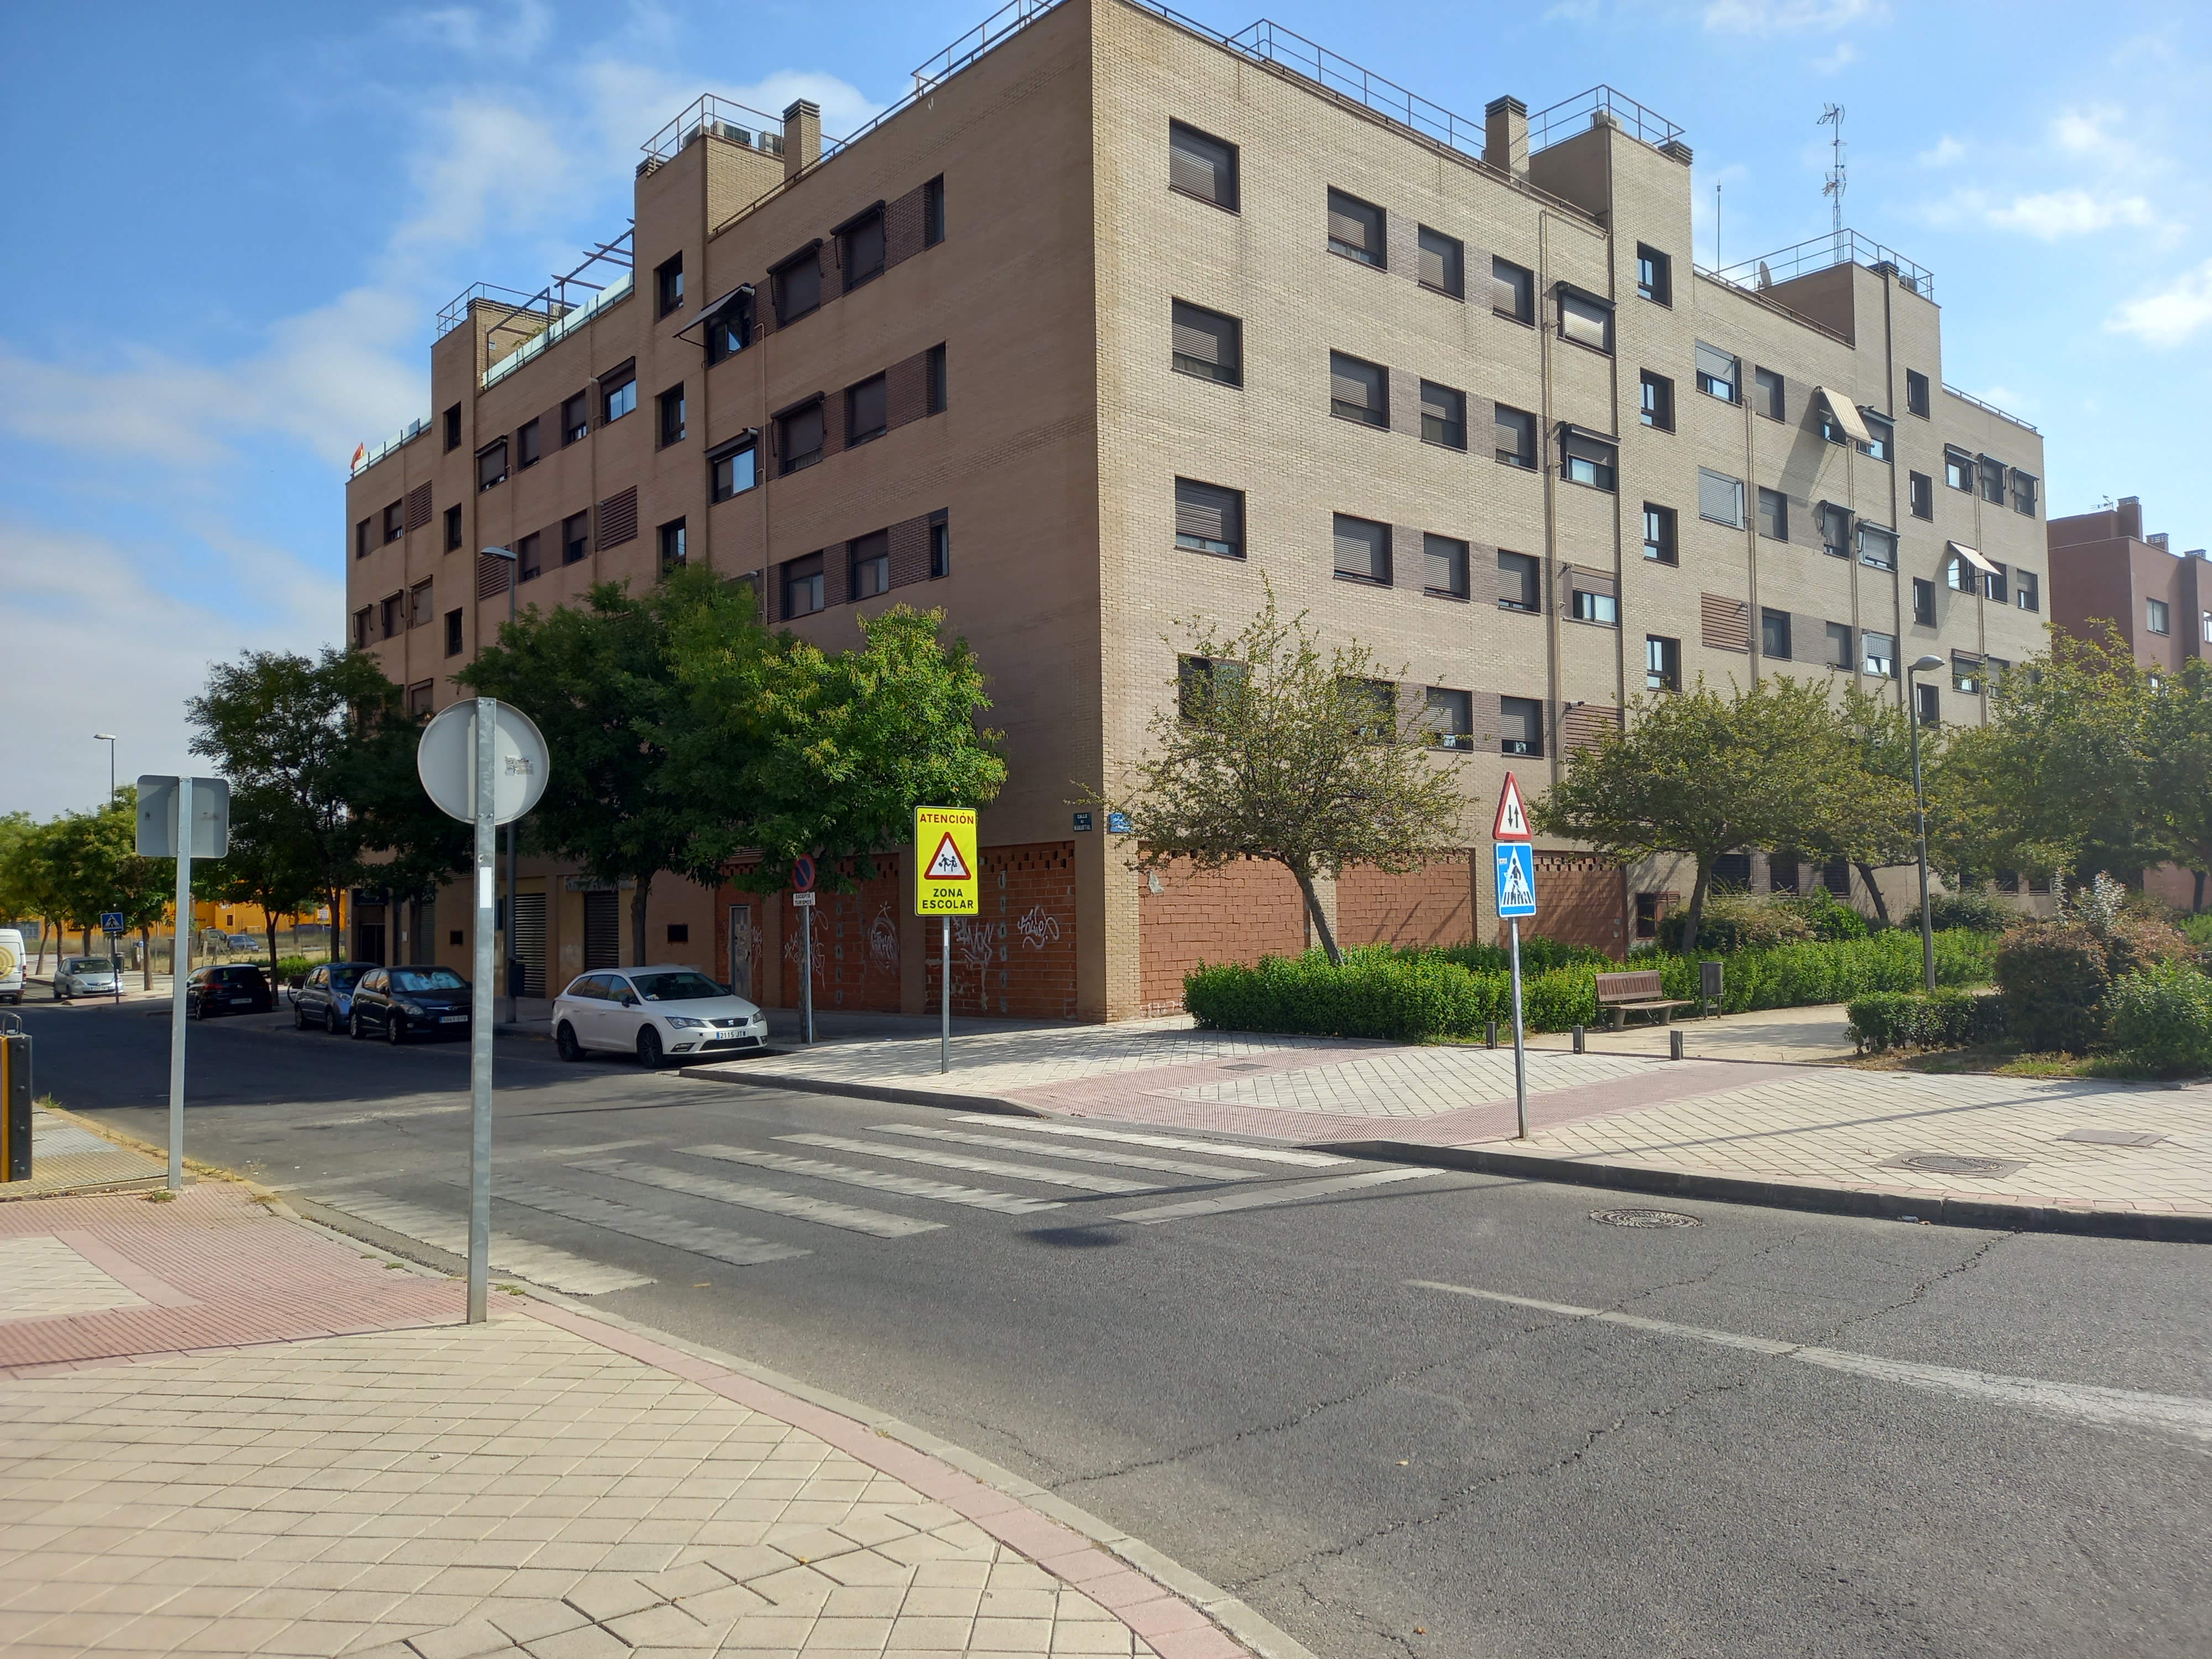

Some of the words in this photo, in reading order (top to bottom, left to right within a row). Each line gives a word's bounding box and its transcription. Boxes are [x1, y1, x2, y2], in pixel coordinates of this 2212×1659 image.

[920, 812, 974, 825] ATENCIÓN
[933, 888, 963, 898] ZONA
[922, 900, 974, 909] ESCOLAR
